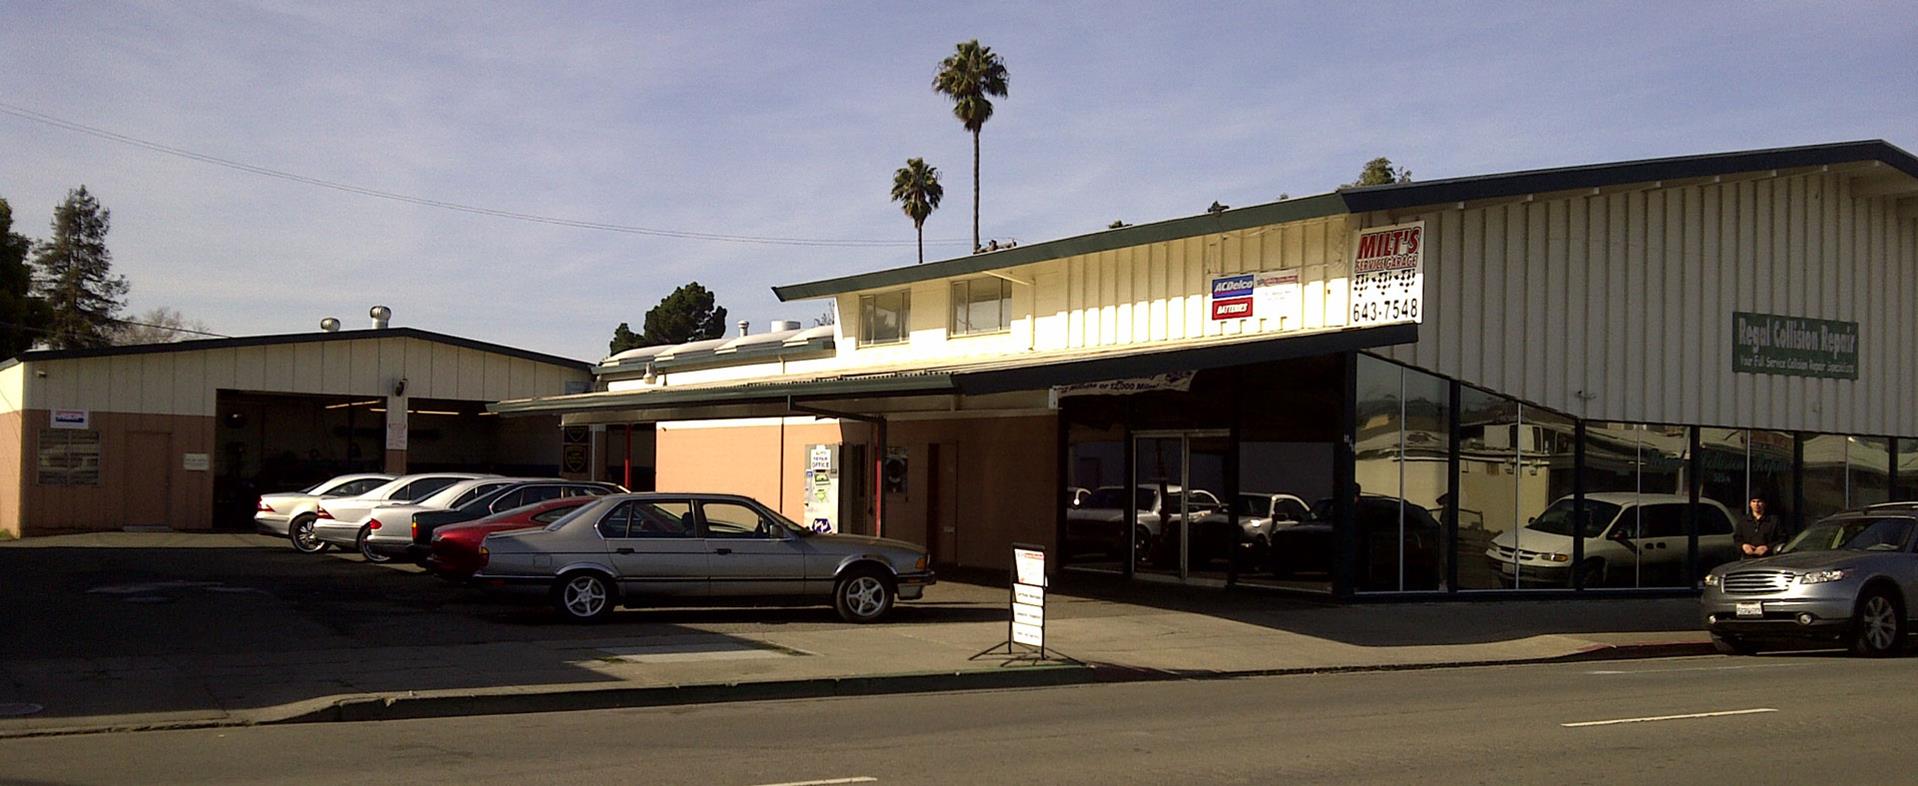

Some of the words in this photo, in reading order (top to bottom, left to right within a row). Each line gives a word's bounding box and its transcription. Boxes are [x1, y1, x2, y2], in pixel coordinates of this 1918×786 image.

[1358, 227, 1421, 260] MILT'S
[1354, 258, 1385, 273] SERVICE
[1386, 254, 1418, 270] GARAGE
[1214, 280, 1253, 292] ACDelco
[1353, 298, 1418, 322] 643-7548
[1739, 317, 1770, 353] Regal
[1773, 320, 1818, 351] Collision
[1821, 324, 1855, 359] Repair
